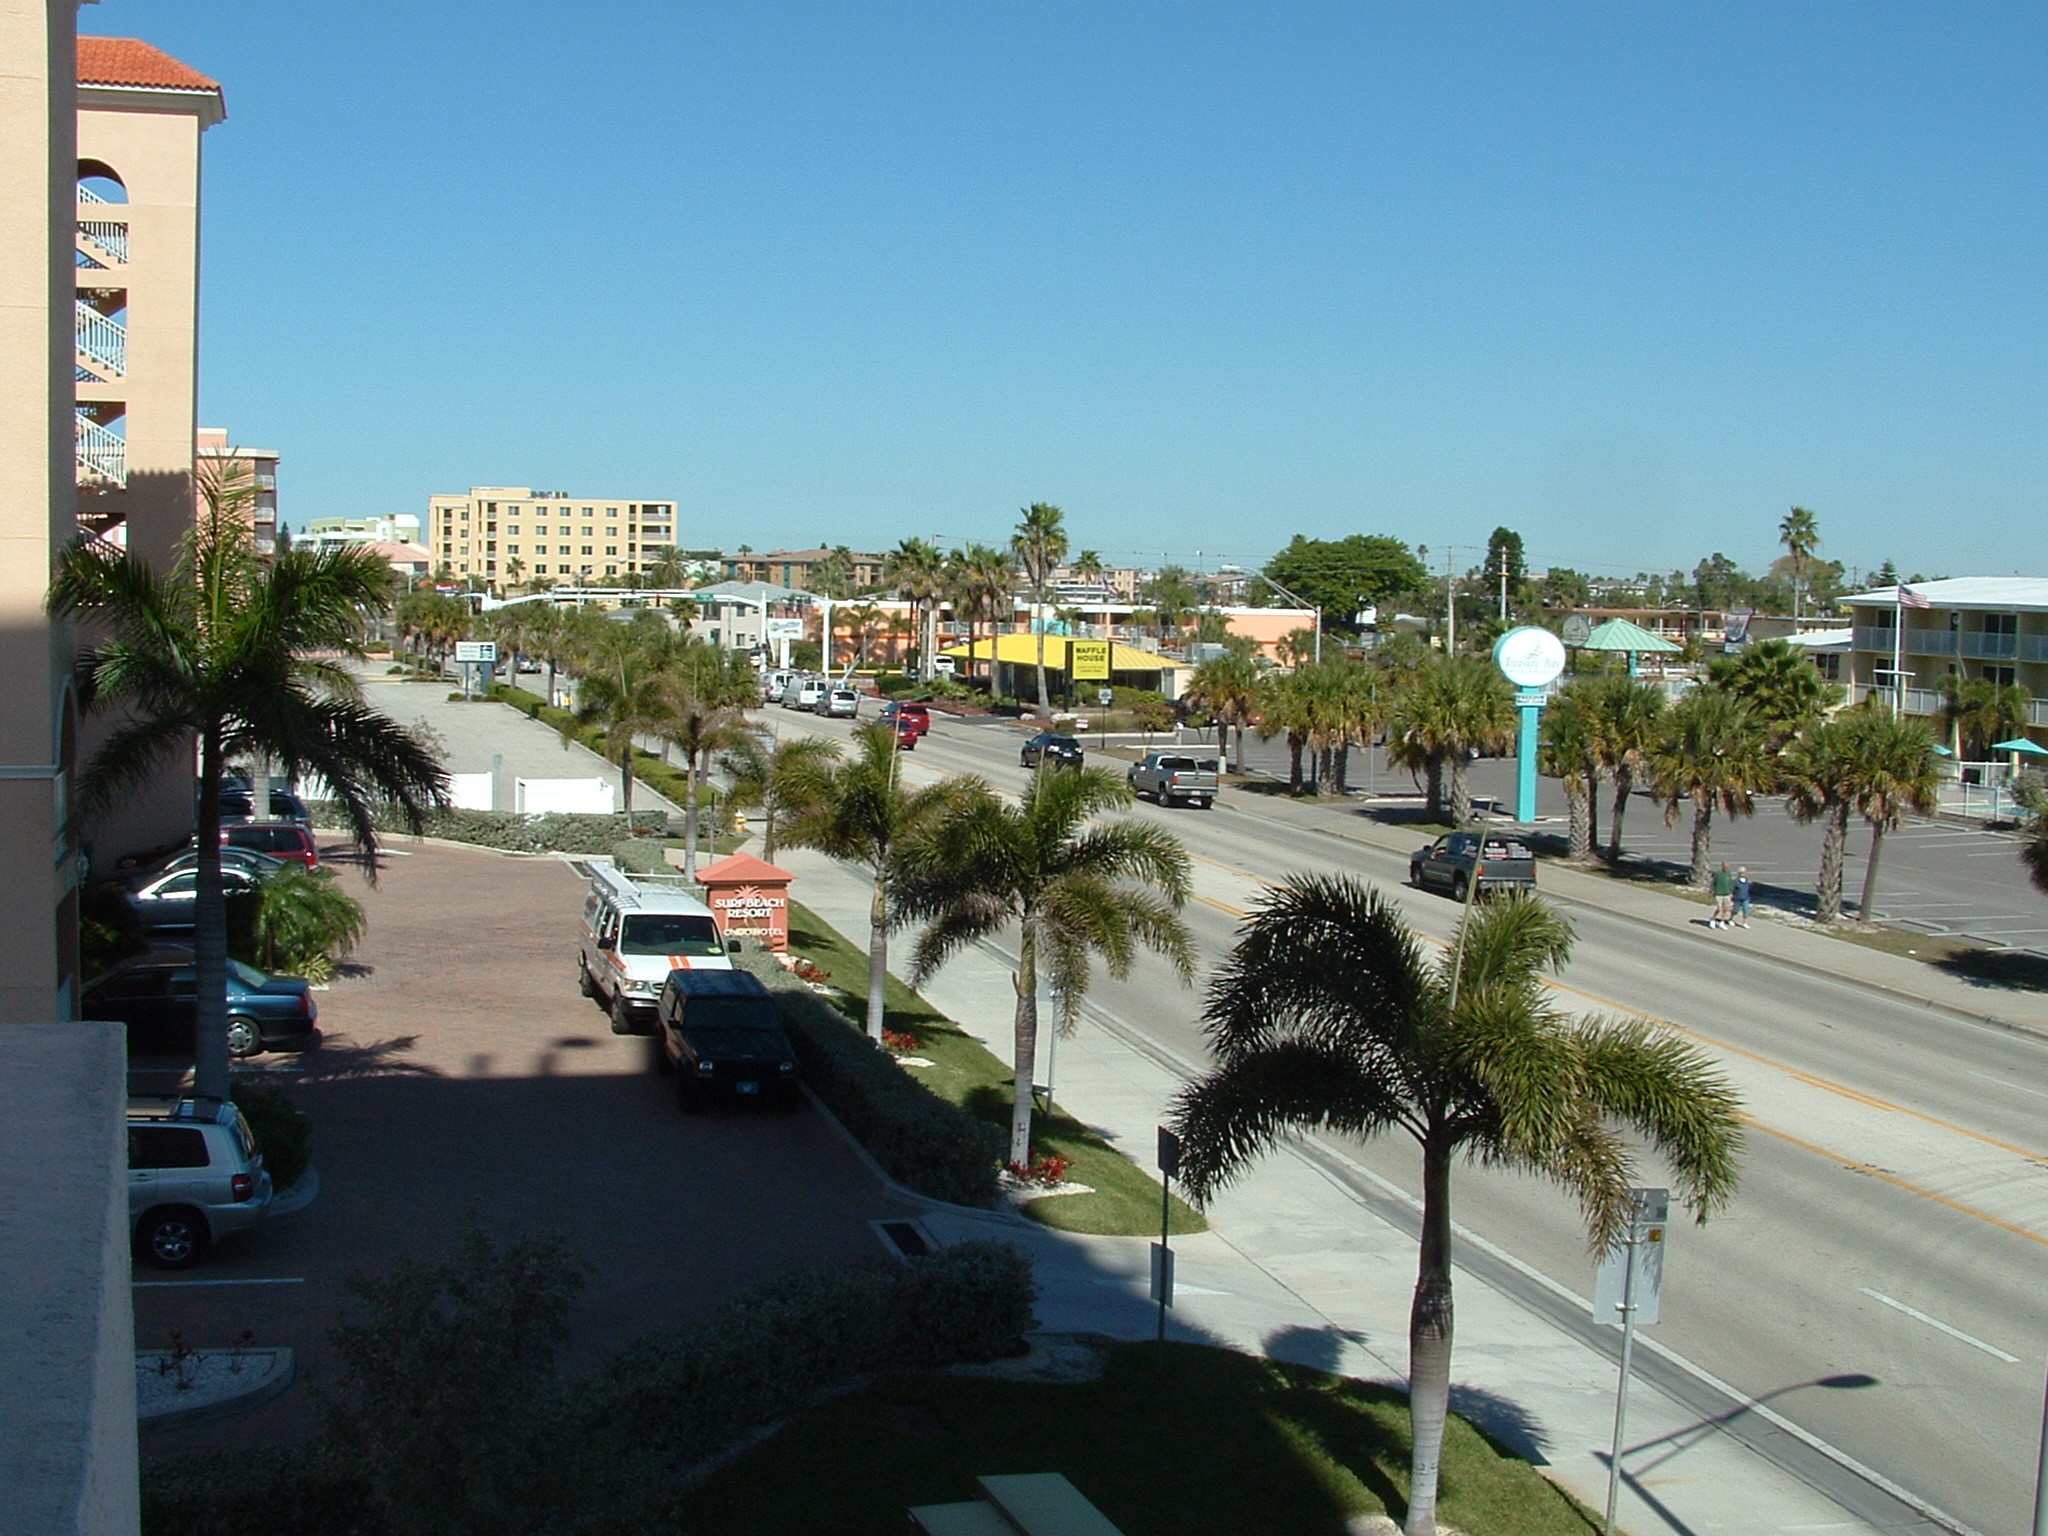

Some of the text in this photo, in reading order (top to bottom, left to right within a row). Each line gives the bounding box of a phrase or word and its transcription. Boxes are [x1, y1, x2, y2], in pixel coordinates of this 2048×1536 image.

[714, 898, 785, 908] SURF BEACH
[727, 908, 773, 918] RESORT
[753, 928, 784, 937] HOTEL
